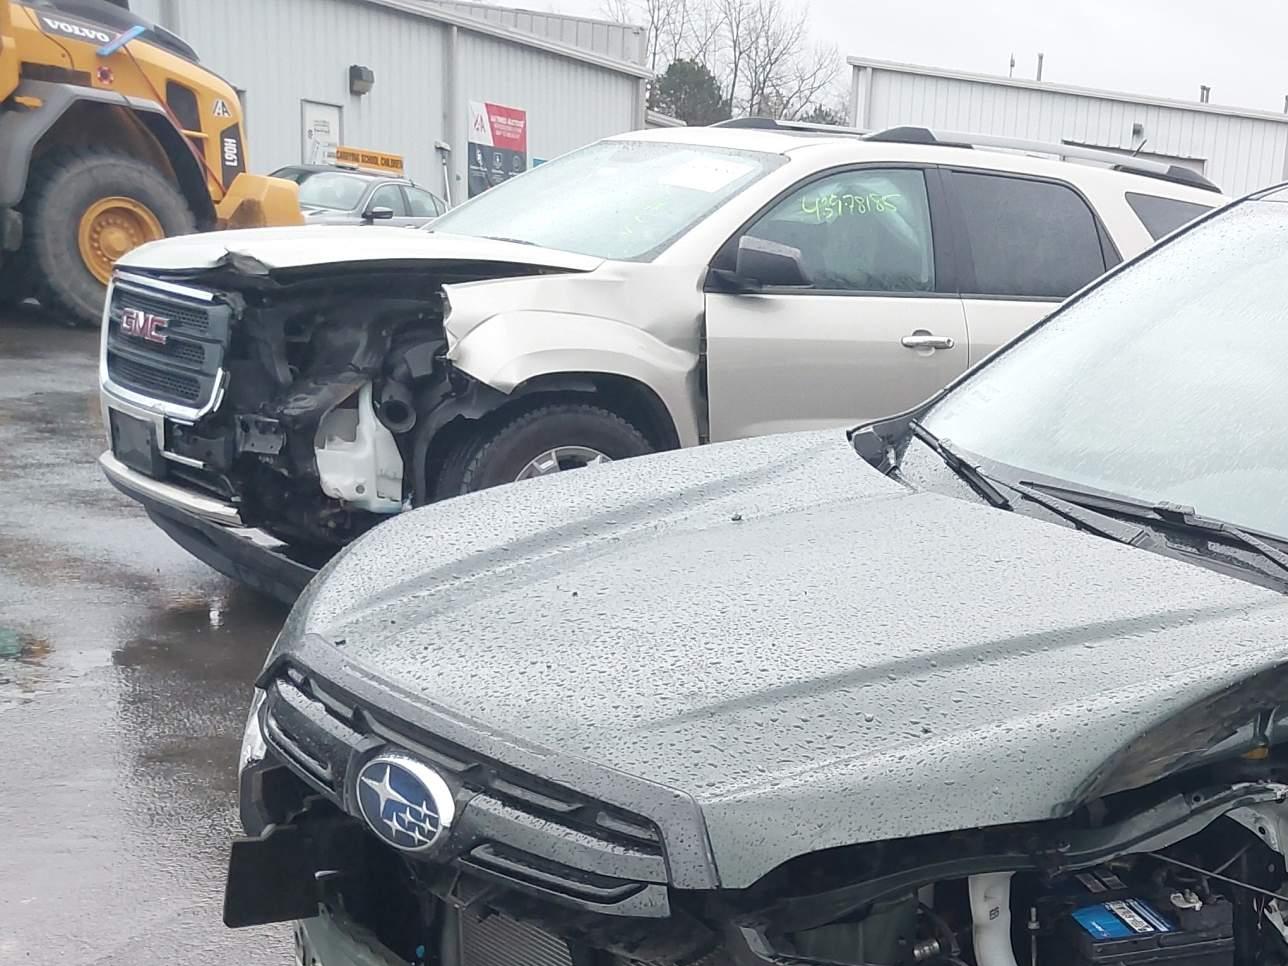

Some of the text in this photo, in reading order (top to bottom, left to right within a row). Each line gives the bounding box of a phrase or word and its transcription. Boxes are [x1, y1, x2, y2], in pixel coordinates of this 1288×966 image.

[42, 17, 110, 42] VOLVO
[223, 137, 238, 167] L90H
[122, 307, 169, 345] GMC
